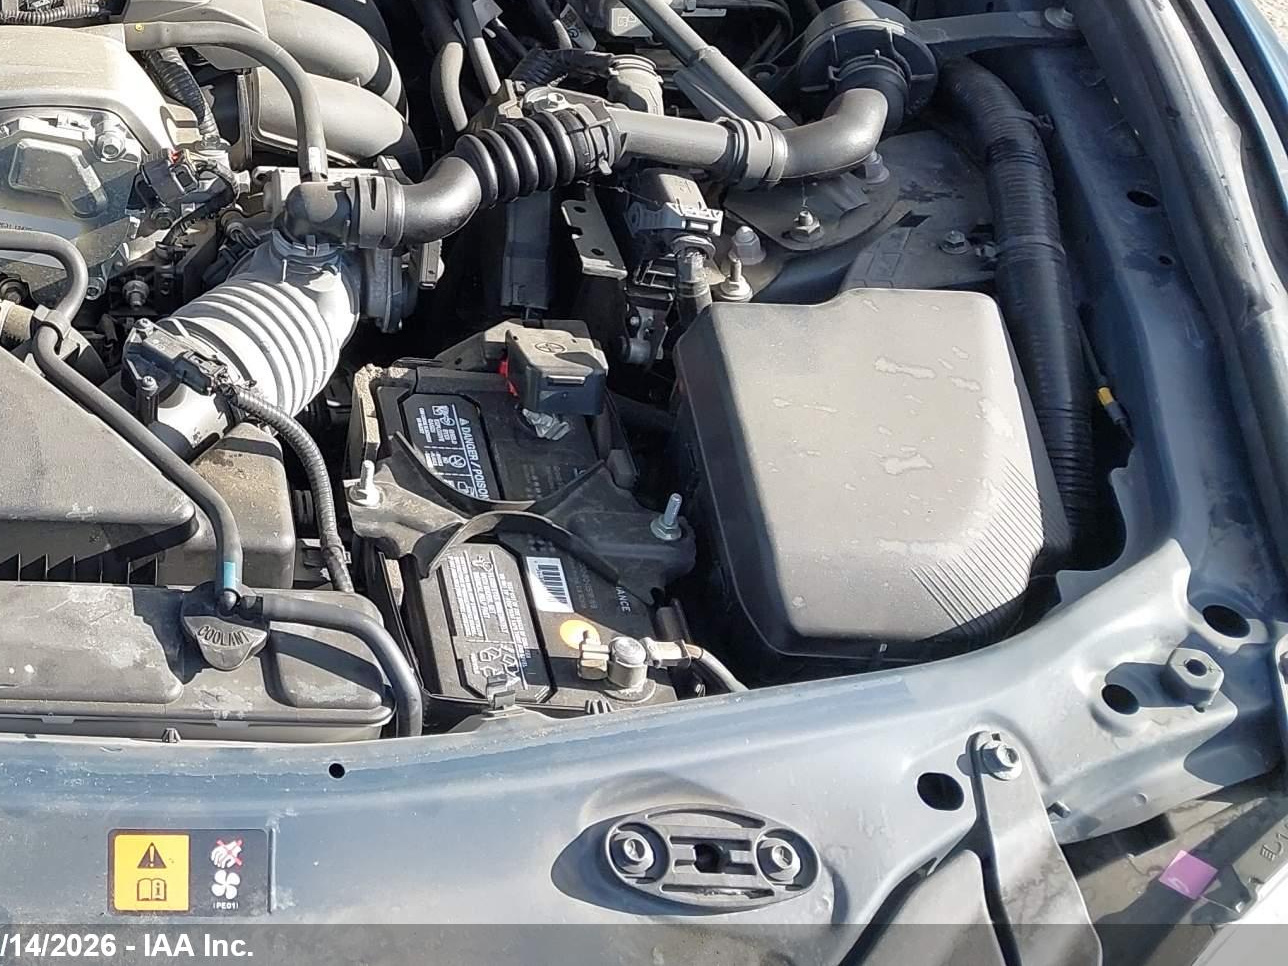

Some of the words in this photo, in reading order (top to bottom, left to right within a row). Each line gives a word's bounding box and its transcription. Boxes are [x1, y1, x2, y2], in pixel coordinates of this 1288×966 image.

[461, 426, 478, 461] DANGER
[472, 468, 490, 499] POISON
[198, 624, 250, 646] COOLANT
